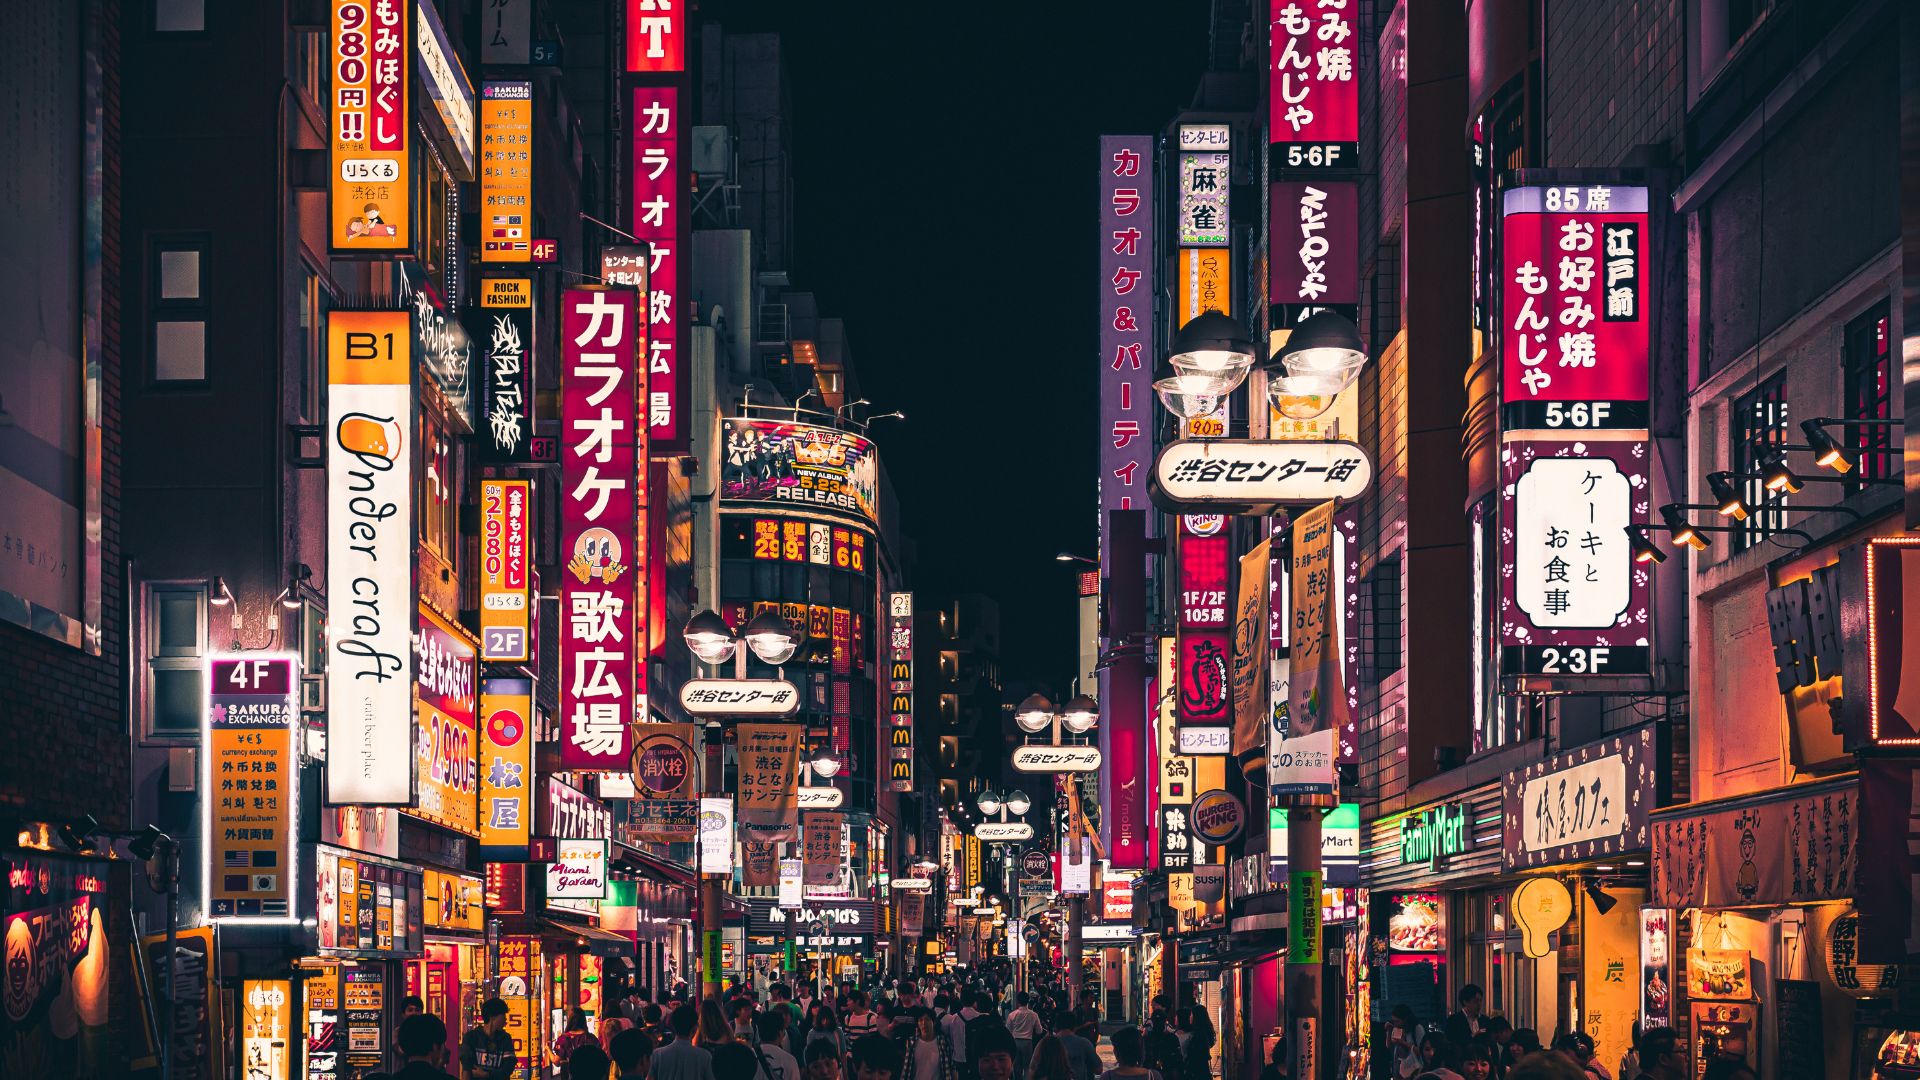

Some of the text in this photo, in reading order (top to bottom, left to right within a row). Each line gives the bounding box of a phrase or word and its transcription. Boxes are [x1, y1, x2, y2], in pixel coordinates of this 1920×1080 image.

[640, 0, 672, 57] T
[1316, 0, 1351, 81] み焼
[1277, 3, 1313, 131] もんじゃ
[1181, 131, 1228, 144] センタービル
[1214, 155, 1229, 164] 5F
[346, 164, 394, 177] りらくる
[352, 185, 389, 200] 渋谷店
[1191, 167, 1217, 230] 麻雀
[533, 245, 554, 258] 4F
[1607, 228, 1634, 317] 江戸前
[494, 283, 519, 292] ROCK
[1558, 219, 1596, 368] お好み焼
[487, 294, 526, 304] FASHION
[1514, 261, 1551, 395] もんじゃ
[346, 332, 394, 360] B1
[535, 441, 553, 457] 3F
[797, 469, 842, 482] NEW ALBUM
[1168, 459, 1361, 482] 渋谷センター街
[800, 476, 840, 493] 5.23
[777, 487, 856, 509] RELEASE
[571, 292, 625, 756] カラオケ歌広場
[1580, 470, 1602, 582] ケーキと
[508, 490, 522, 584] 全身もみほぐし
[1543, 526, 1570, 616] お食事
[487, 596, 521, 607] りらくる
[1183, 592, 1225, 605] 1F/2F
[1184, 608, 1225, 622] 105席
[337, 578, 403, 683] craft
[490, 632, 519, 652] 2F
[229, 660, 270, 688] 4F
[687, 690, 791, 704] 渋谷センター街
[228, 703, 290, 715] SAKURA
[228, 714, 281, 724] EXCHANGE
[1181, 733, 1228, 746] センタービル
[221, 748, 278, 758] currency exchange
[1018, 753, 1098, 764] 渋谷センター街
[643, 758, 683, 777] 消火栓
[755, 756, 783, 770] 渋谷
[1166, 760, 1188, 777] 鍋
[743, 772, 794, 786] おとなり
[487, 757, 523, 829] 松屋
[742, 789, 794, 801] サンデー
[1198, 802, 1236, 819] BURGER
[1536, 777, 1610, 844] 椿屋カフェ
[745, 823, 792, 831] Panasonic
[1201, 814, 1238, 832] KING
[224, 828, 274, 841] 外貨両替
[1400, 804, 1465, 872] FamilyMart
[806, 843, 839, 851] おとなり
[807, 853, 839, 861] サンデー
[1026, 859, 1046, 869] 消火栓
[1165, 856, 1188, 867] B1F
[549, 863, 590, 874] Miami
[1195, 876, 1223, 884] SUSHI
